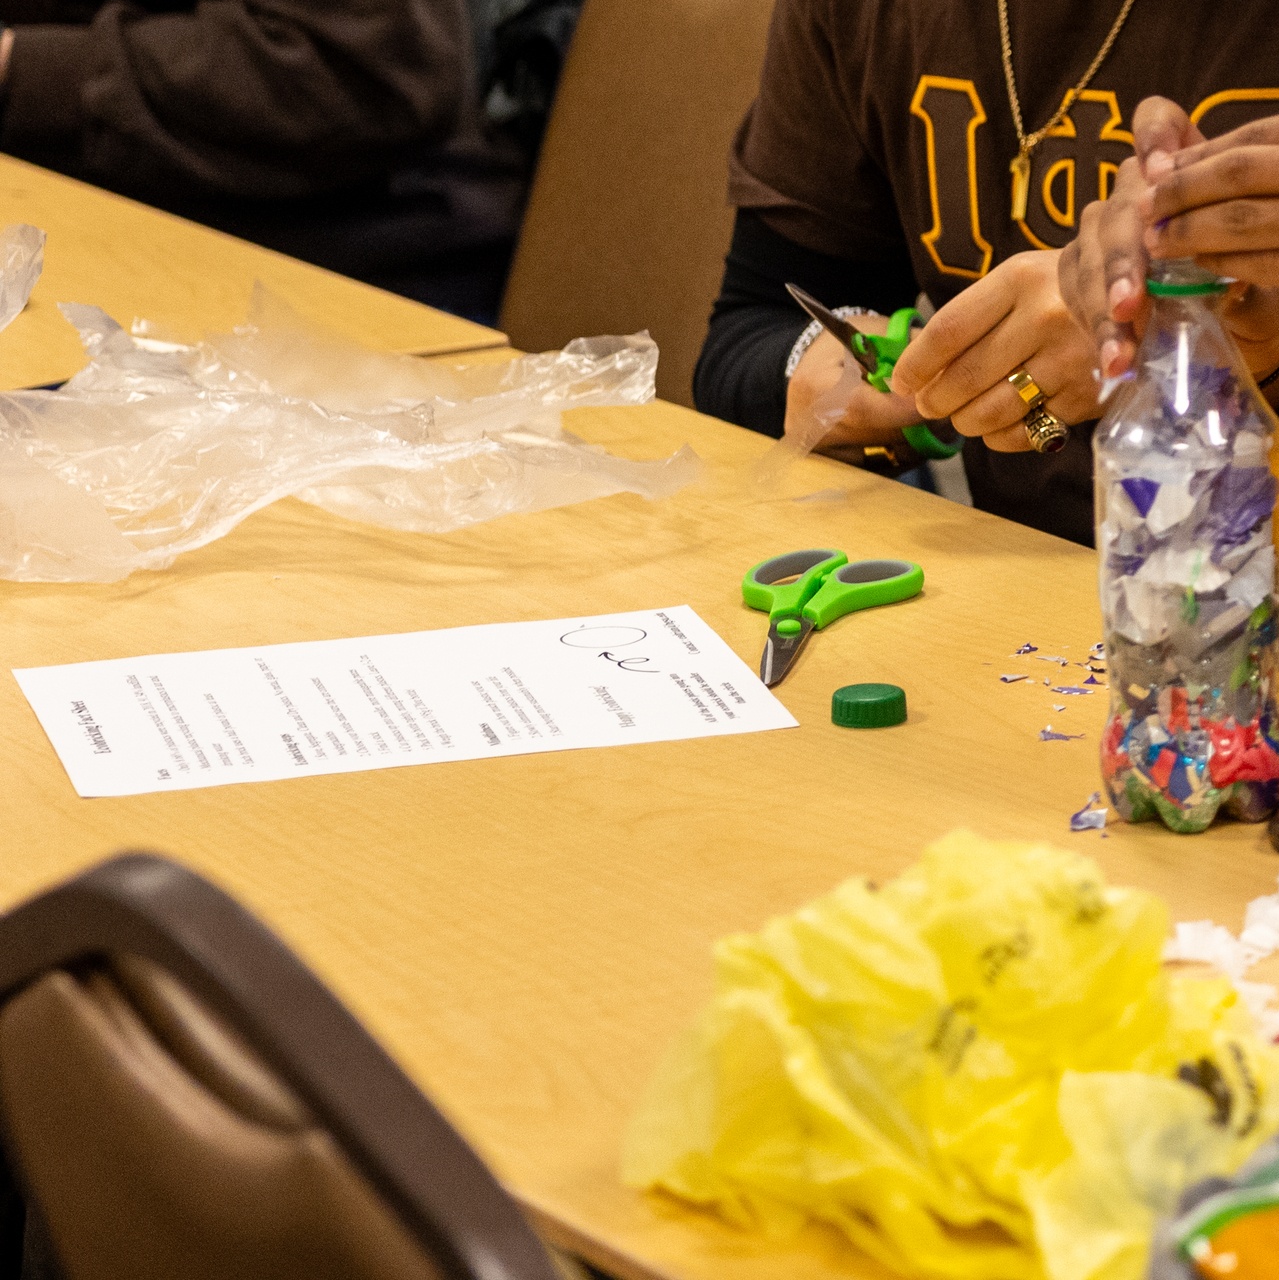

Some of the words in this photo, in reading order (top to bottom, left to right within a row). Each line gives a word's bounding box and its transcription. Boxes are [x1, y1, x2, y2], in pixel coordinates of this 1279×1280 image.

[71, 701, 88, 713] Sheet
[78, 714, 95, 725] Fact
[616, 712, 635, 728] Happy
